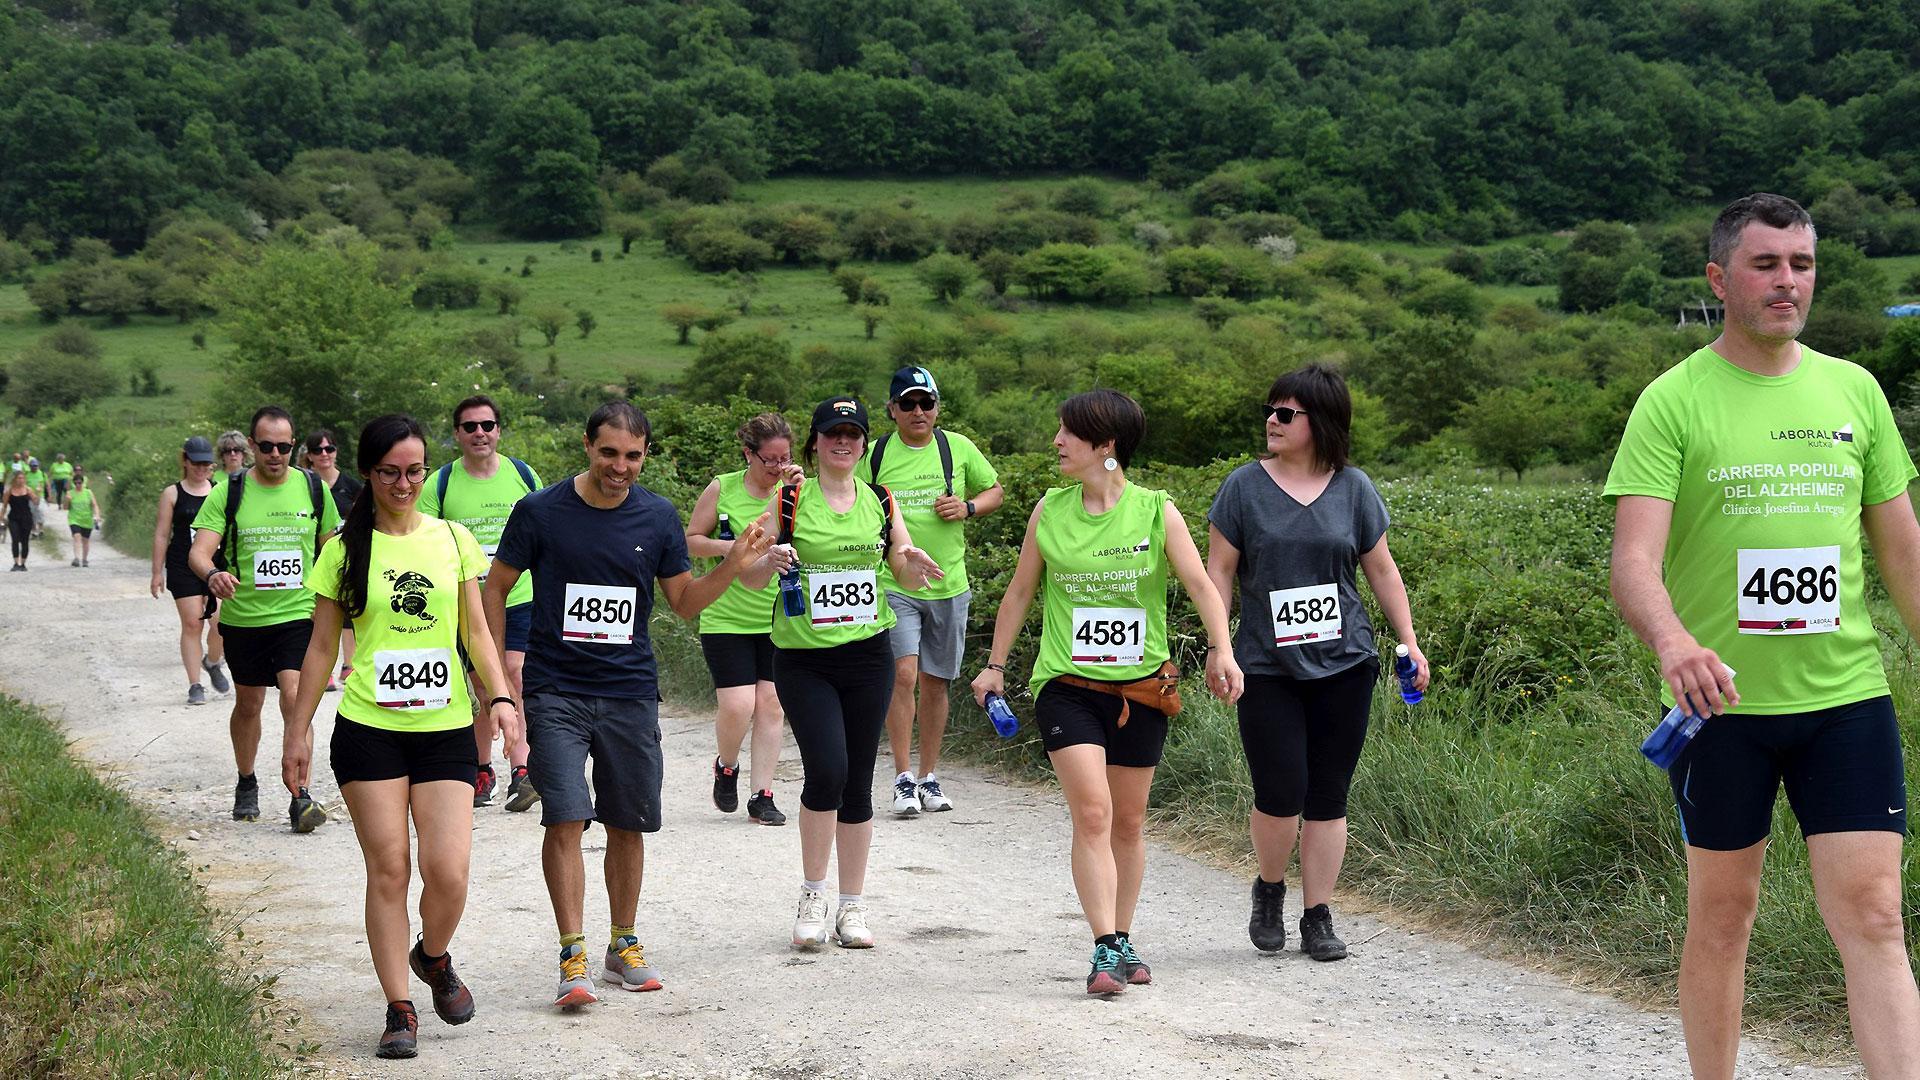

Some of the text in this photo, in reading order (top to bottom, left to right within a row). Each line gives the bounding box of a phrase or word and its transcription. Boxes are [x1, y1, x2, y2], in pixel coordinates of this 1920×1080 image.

[1770, 429, 1831, 440] LABORAL
[1808, 440, 1833, 449] kutxa
[1707, 463, 1856, 482] CARRERA POPULAR
[1724, 482, 1845, 499] DEL ALZHEIMER
[1763, 502, 1810, 517] Josefina
[838, 544, 875, 552] LABORAL
[1092, 546, 1132, 557] LABORAL
[256, 558, 301, 577] 4655
[1053, 567, 1150, 583] CARRERA POPULAR
[813, 581, 875, 608] 4583
[1742, 564, 1837, 606] 4686
[567, 596, 632, 624] 4850
[1276, 596, 1339, 626] 4582
[1075, 620, 1140, 646] 4581
[378, 660, 449, 690] 4849
